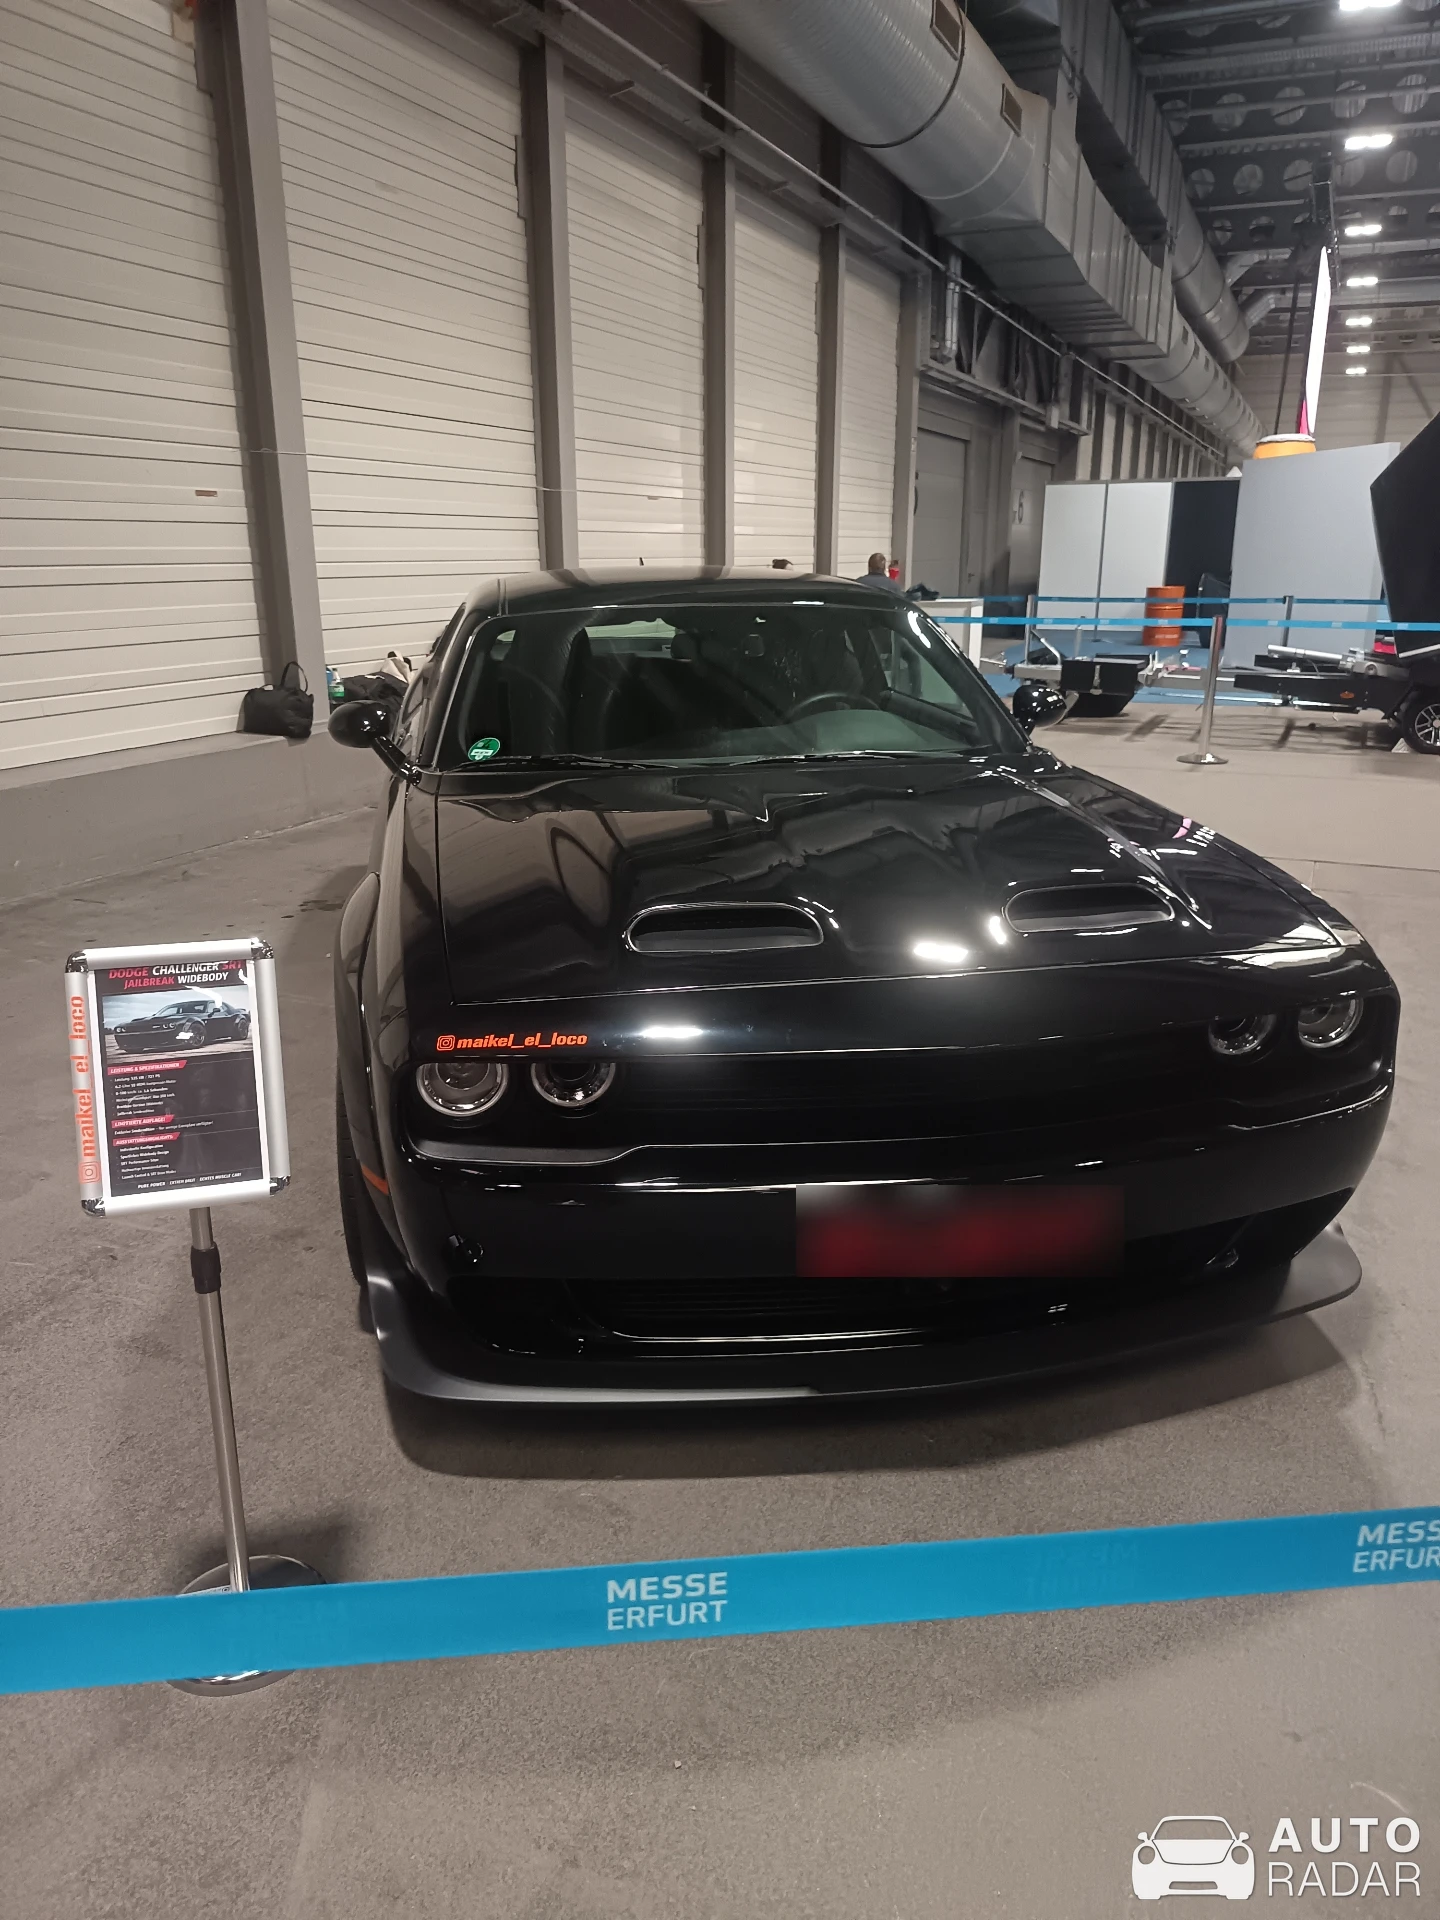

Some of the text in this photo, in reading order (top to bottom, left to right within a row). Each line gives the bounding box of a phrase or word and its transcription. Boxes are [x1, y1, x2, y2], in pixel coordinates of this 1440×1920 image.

[109, 966, 149, 979] DODGE
[152, 962, 219, 976] CHALLENGER
[124, 971, 229, 990] JAILBREAK WIDEBODY
[456, 1032, 588, 1049] maikel_el_loco
[68, 996, 97, 1158] maikel_el_loco
[607, 1571, 729, 1603] MESSE
[607, 1600, 729, 1631] ERFURT
